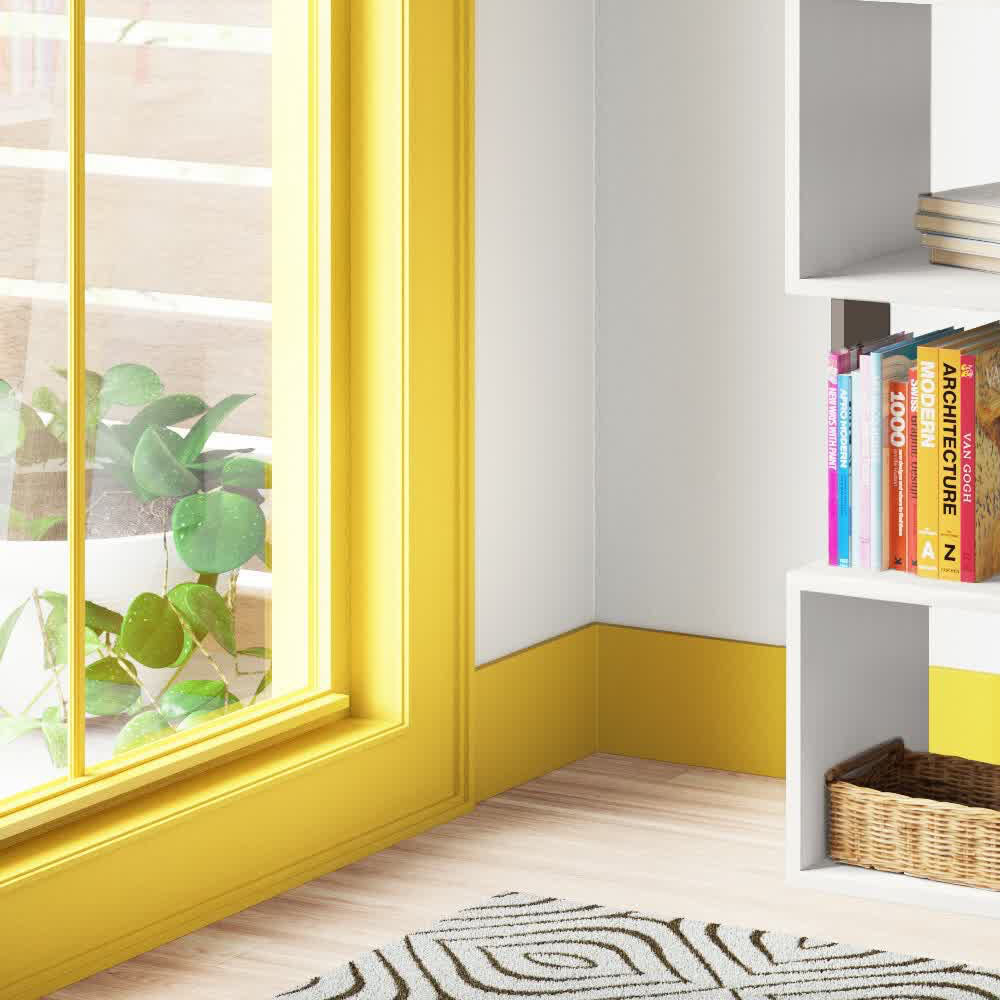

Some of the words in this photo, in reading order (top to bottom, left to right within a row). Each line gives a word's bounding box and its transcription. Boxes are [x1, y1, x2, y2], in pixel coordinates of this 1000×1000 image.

[890, 392, 905, 448] 1000
[920, 361, 936, 448] MODERN
[840, 420, 848, 468] MODERN
[943, 363, 957, 515] ARCHITECTURE
[963, 432, 971, 459] VAN
[963, 463, 971, 503] GOGH
[921, 540, 936, 560] A
[944, 543, 956, 562] Z
